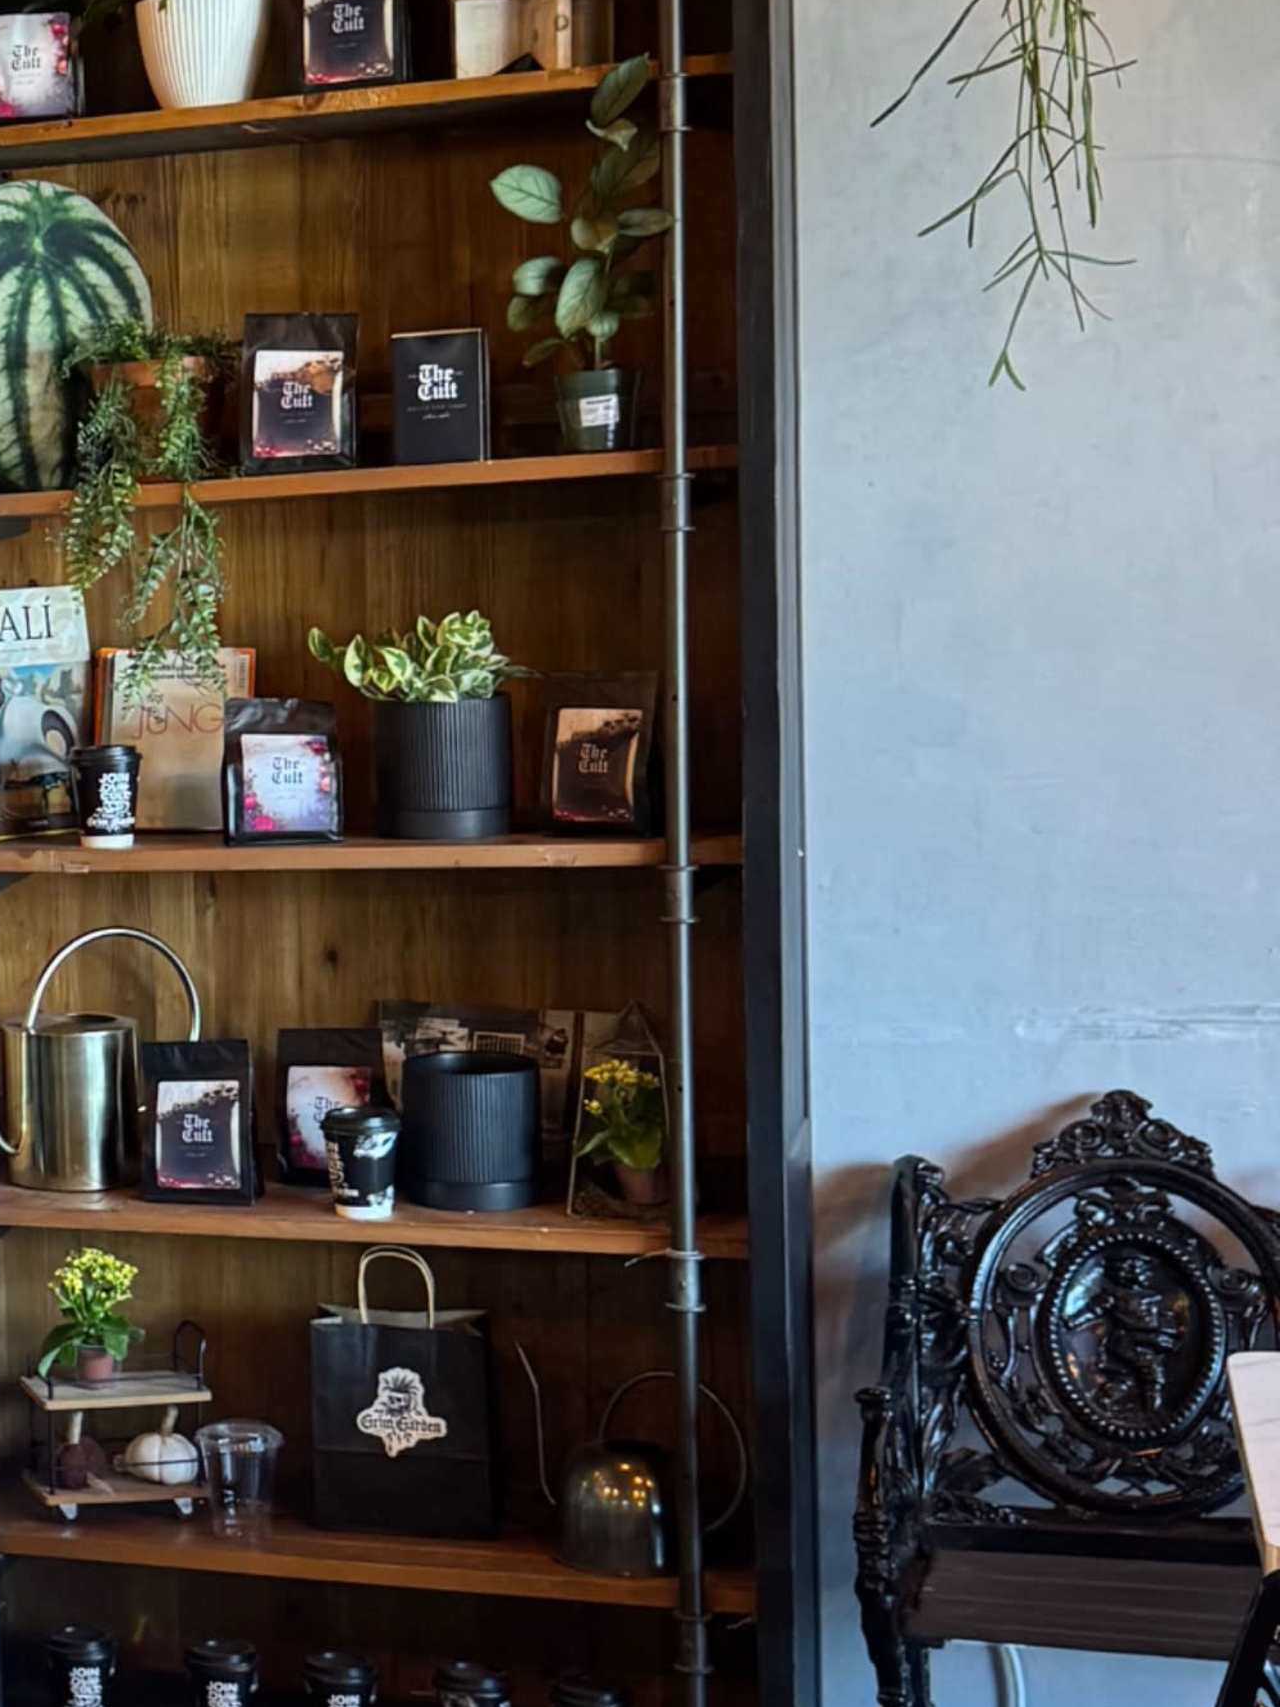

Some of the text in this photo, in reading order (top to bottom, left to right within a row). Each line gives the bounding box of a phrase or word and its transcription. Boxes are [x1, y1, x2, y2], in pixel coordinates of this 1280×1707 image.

[333, 3, 362, 19] The
[331, 17, 364, 34] Cult
[11, 44, 39, 57] The
[10, 56, 42, 71] Cult
[418, 364, 454, 383] The
[282, 381, 311, 396] The
[416, 381, 458, 401] Cult
[280, 394, 313, 409] Cult
[132, 702, 224, 740] JUNG
[580, 743, 608, 759] The
[272, 756, 301, 771] The
[578, 758, 608, 774] Cult
[271, 770, 304, 785] Cult
[183, 1113, 210, 1129] The
[181, 1127, 214, 1144] Cult
[360, 1412, 442, 1433] Grim Garden
